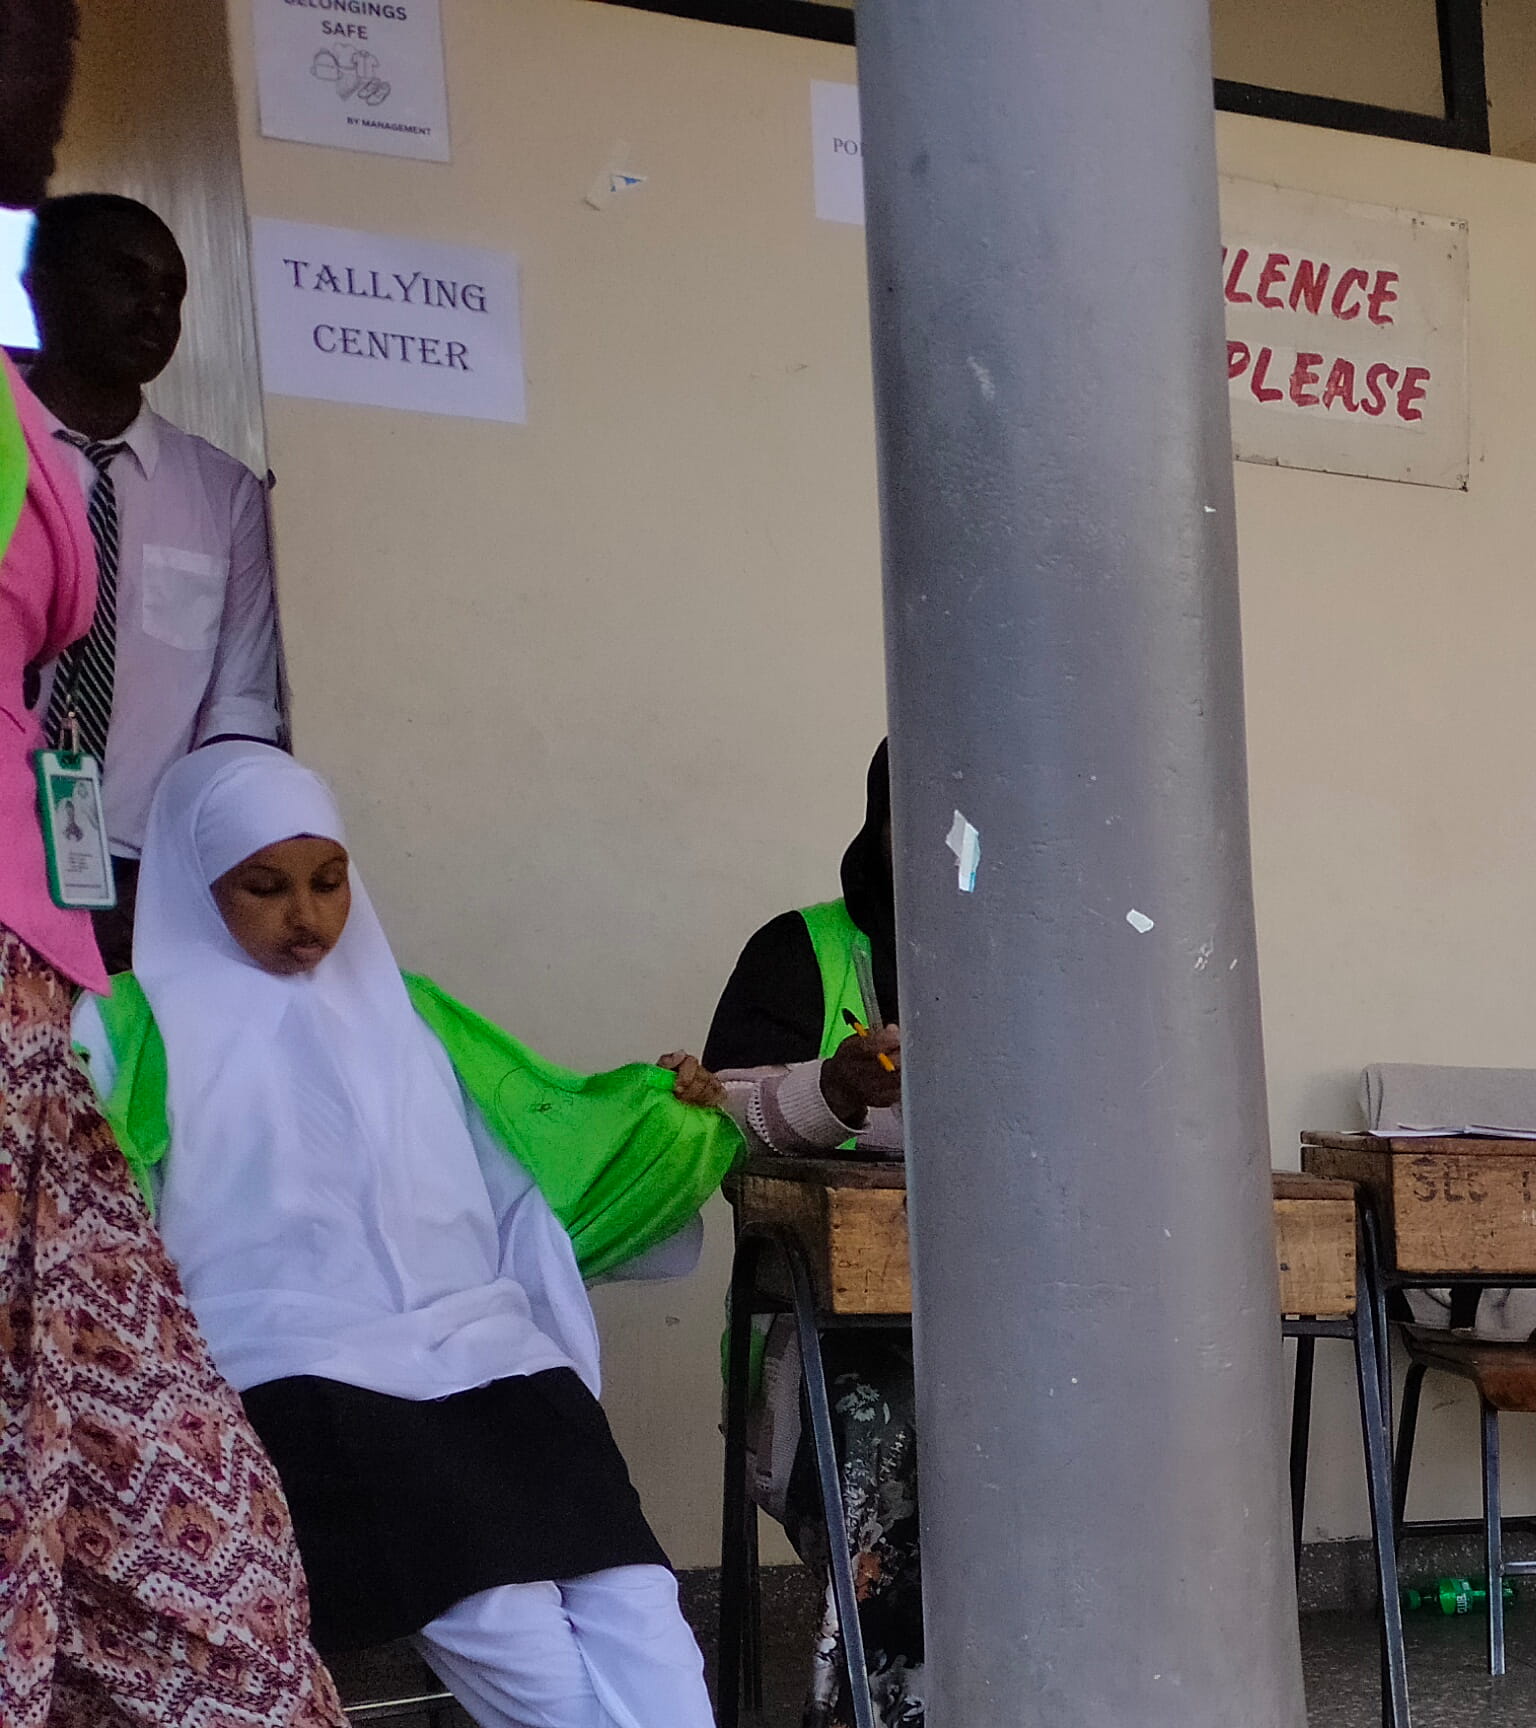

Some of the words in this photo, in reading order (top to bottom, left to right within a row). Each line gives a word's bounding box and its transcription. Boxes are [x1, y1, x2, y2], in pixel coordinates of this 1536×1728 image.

[321, 20, 368, 40] SAFE
[361, 119, 432, 135] MANAGEMENT
[283, 258, 489, 313] TALLYING
[1222, 247, 1399, 326] LENCE
[313, 324, 472, 371] CENTER
[1226, 340, 1431, 421] PLEASE
